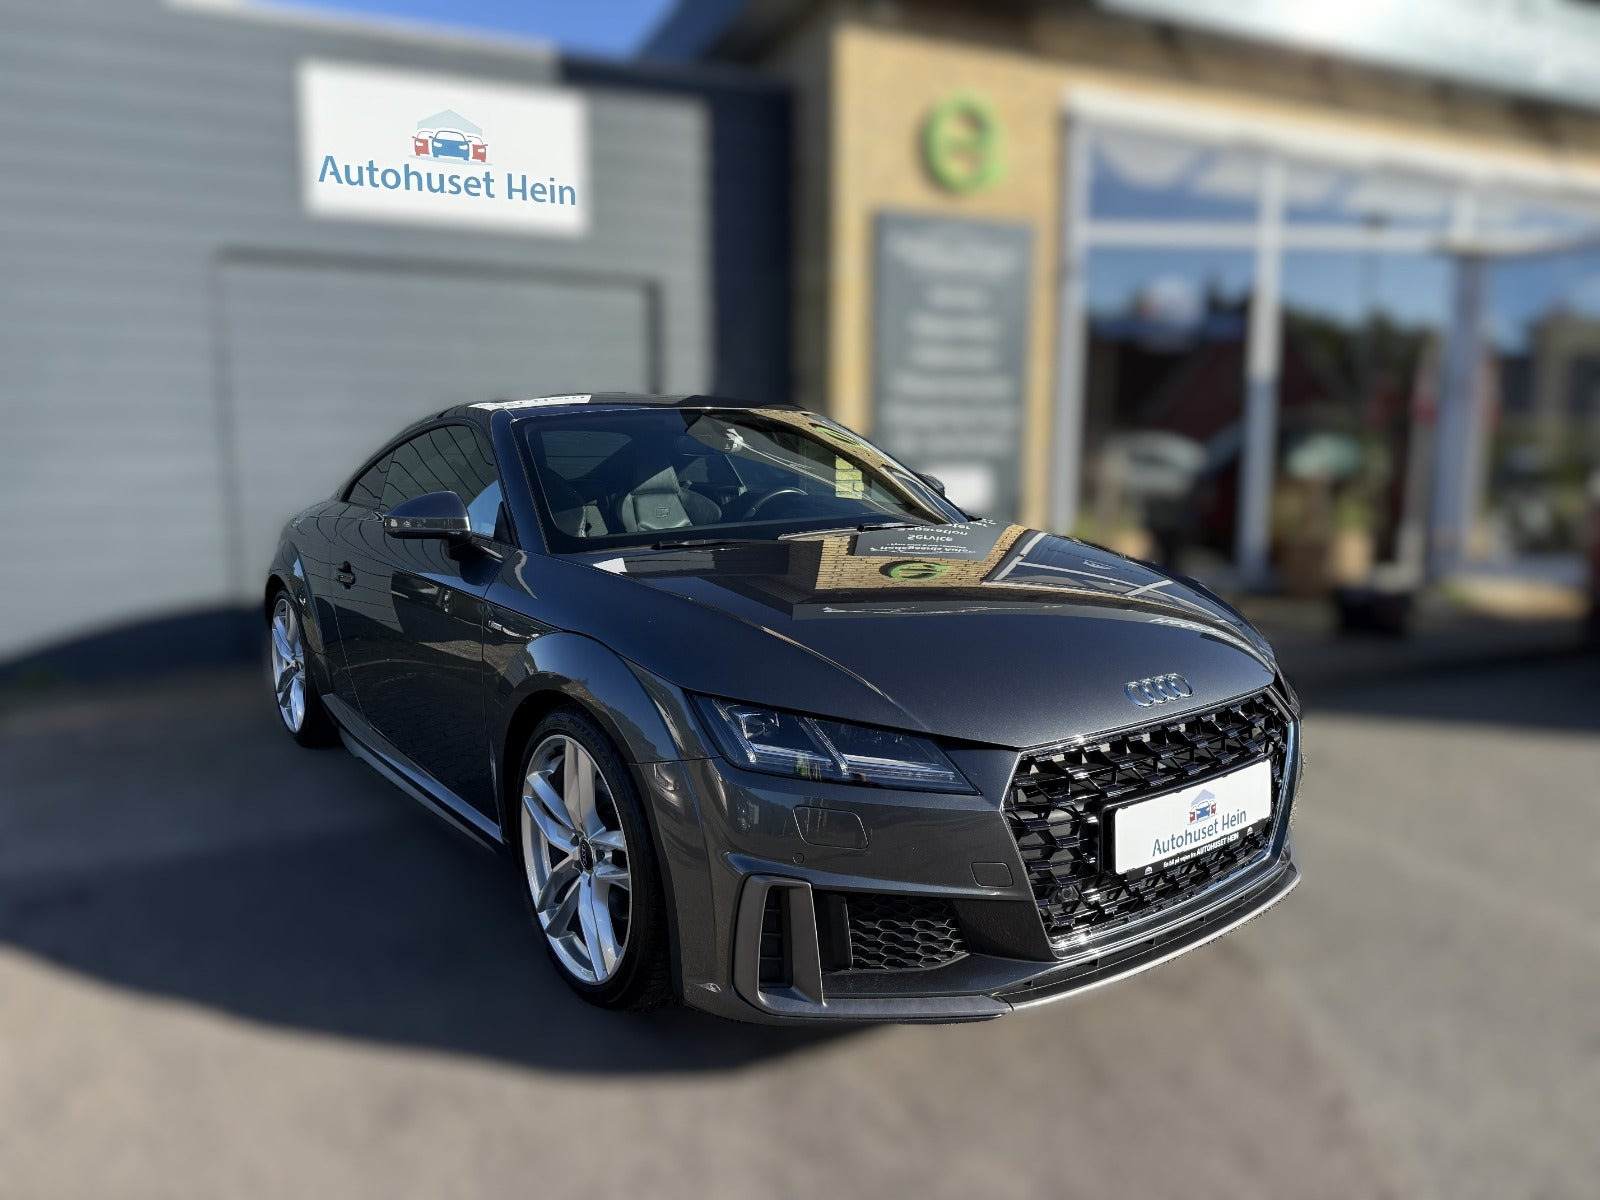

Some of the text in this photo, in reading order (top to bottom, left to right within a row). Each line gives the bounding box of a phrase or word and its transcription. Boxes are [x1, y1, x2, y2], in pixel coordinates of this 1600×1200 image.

[318, 155, 577, 206] Autohuset Hein
[1153, 809, 1246, 857] Autohuset Hein
[1196, 838, 1227, 856] AUTOHUSET
[1226, 831, 1239, 842] HEIN
